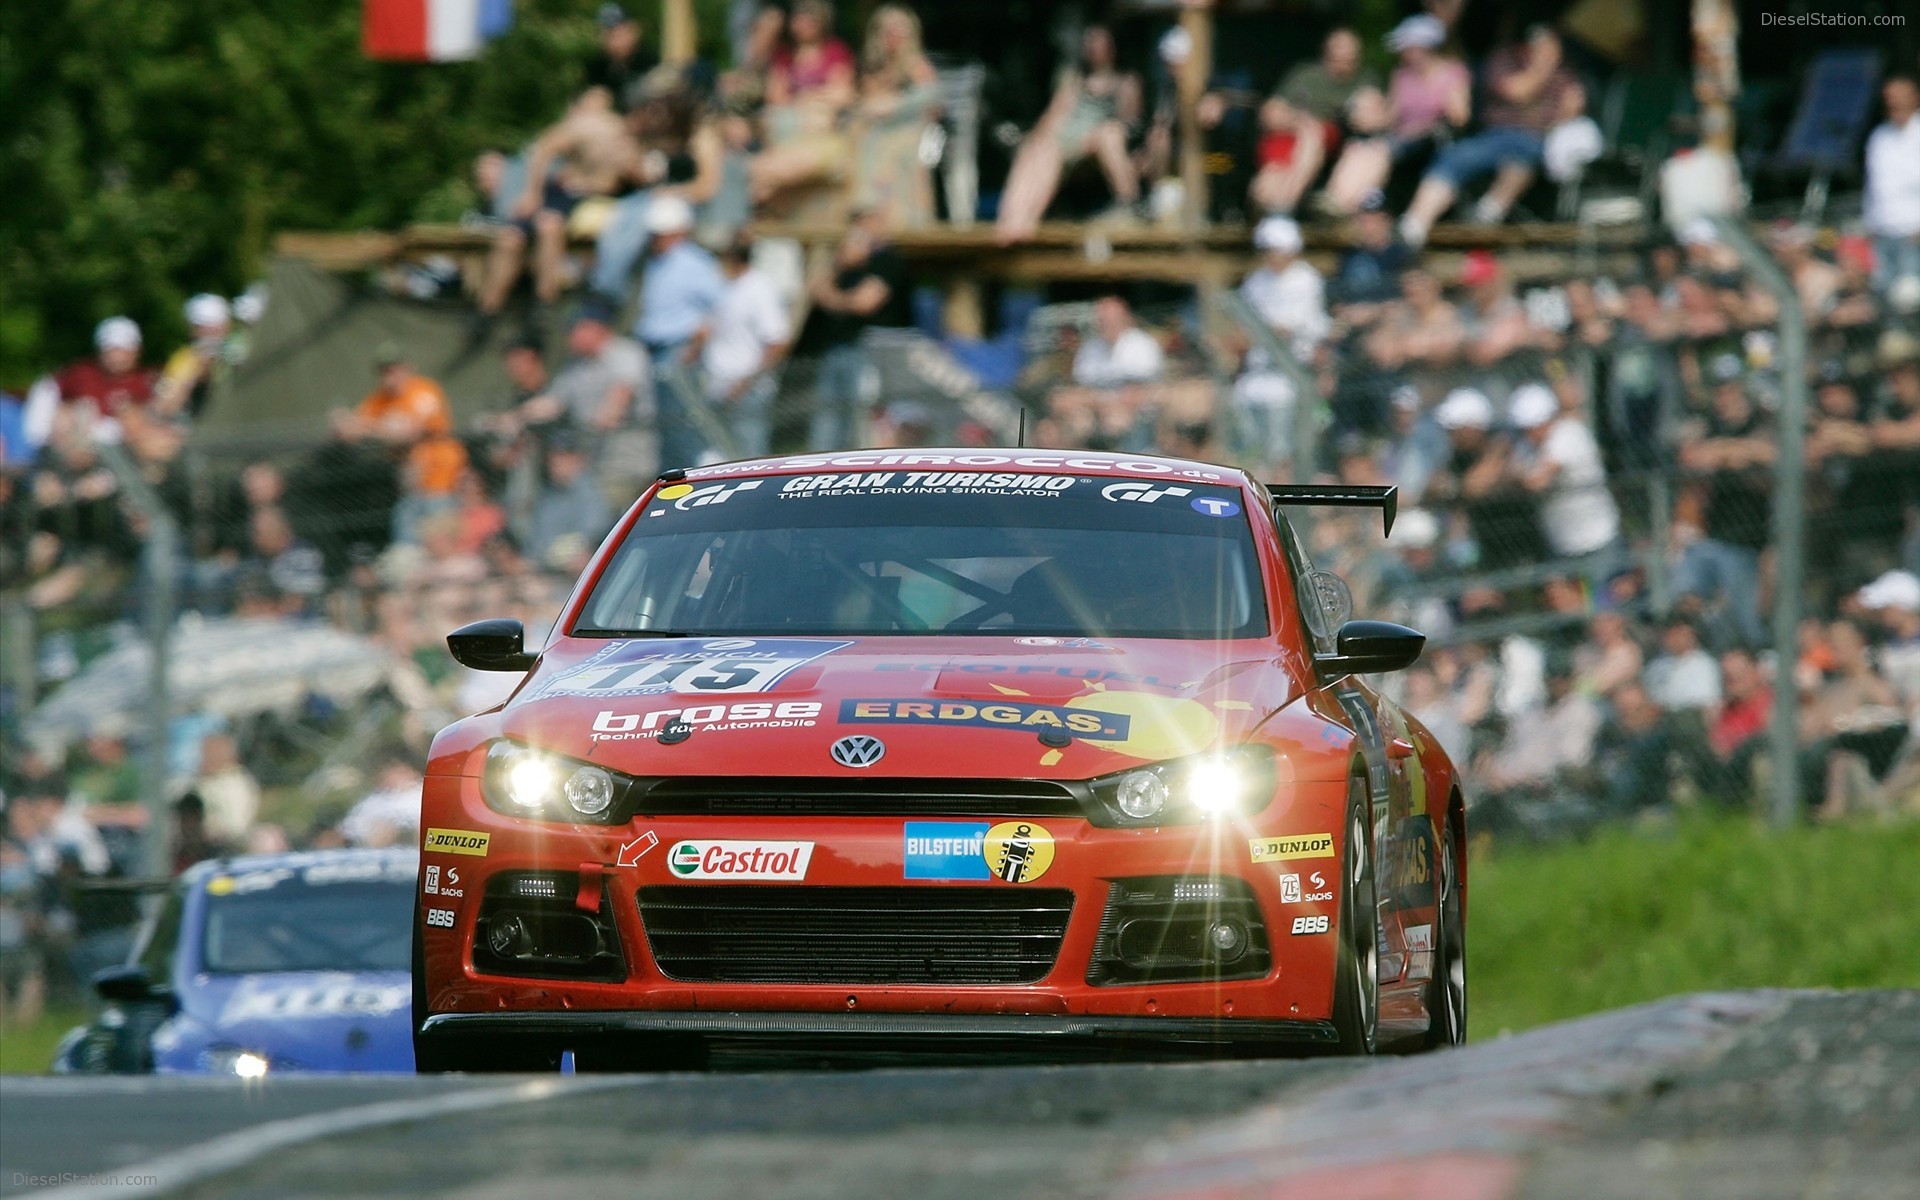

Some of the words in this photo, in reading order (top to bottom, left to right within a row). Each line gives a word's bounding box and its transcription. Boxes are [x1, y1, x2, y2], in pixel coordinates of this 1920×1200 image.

[688, 455, 1220, 480] www.SCIROCCO.de
[782, 473, 895, 492] GRAN
[906, 472, 1076, 490] TURISMO
[778, 491, 816, 500] THE
[820, 488, 868, 496] REAL
[870, 487, 950, 495] DRIVING
[952, 487, 1060, 498] SIMULATOR
[1200, 499, 1230, 515] T
[592, 702, 822, 733] brose
[590, 728, 664, 742] Technik
[702, 719, 816, 731] Automobile
[435, 835, 488, 849] DUNLOP
[908, 838, 982, 857] BILSTEIN
[1267, 839, 1331, 855] DUNLOP
[702, 845, 802, 875] Castrol
[441, 887, 463, 898] SACHS
[1305, 892, 1333, 902] SACHS
[427, 908, 455, 927] BBS
[1291, 916, 1329, 935] BBS
